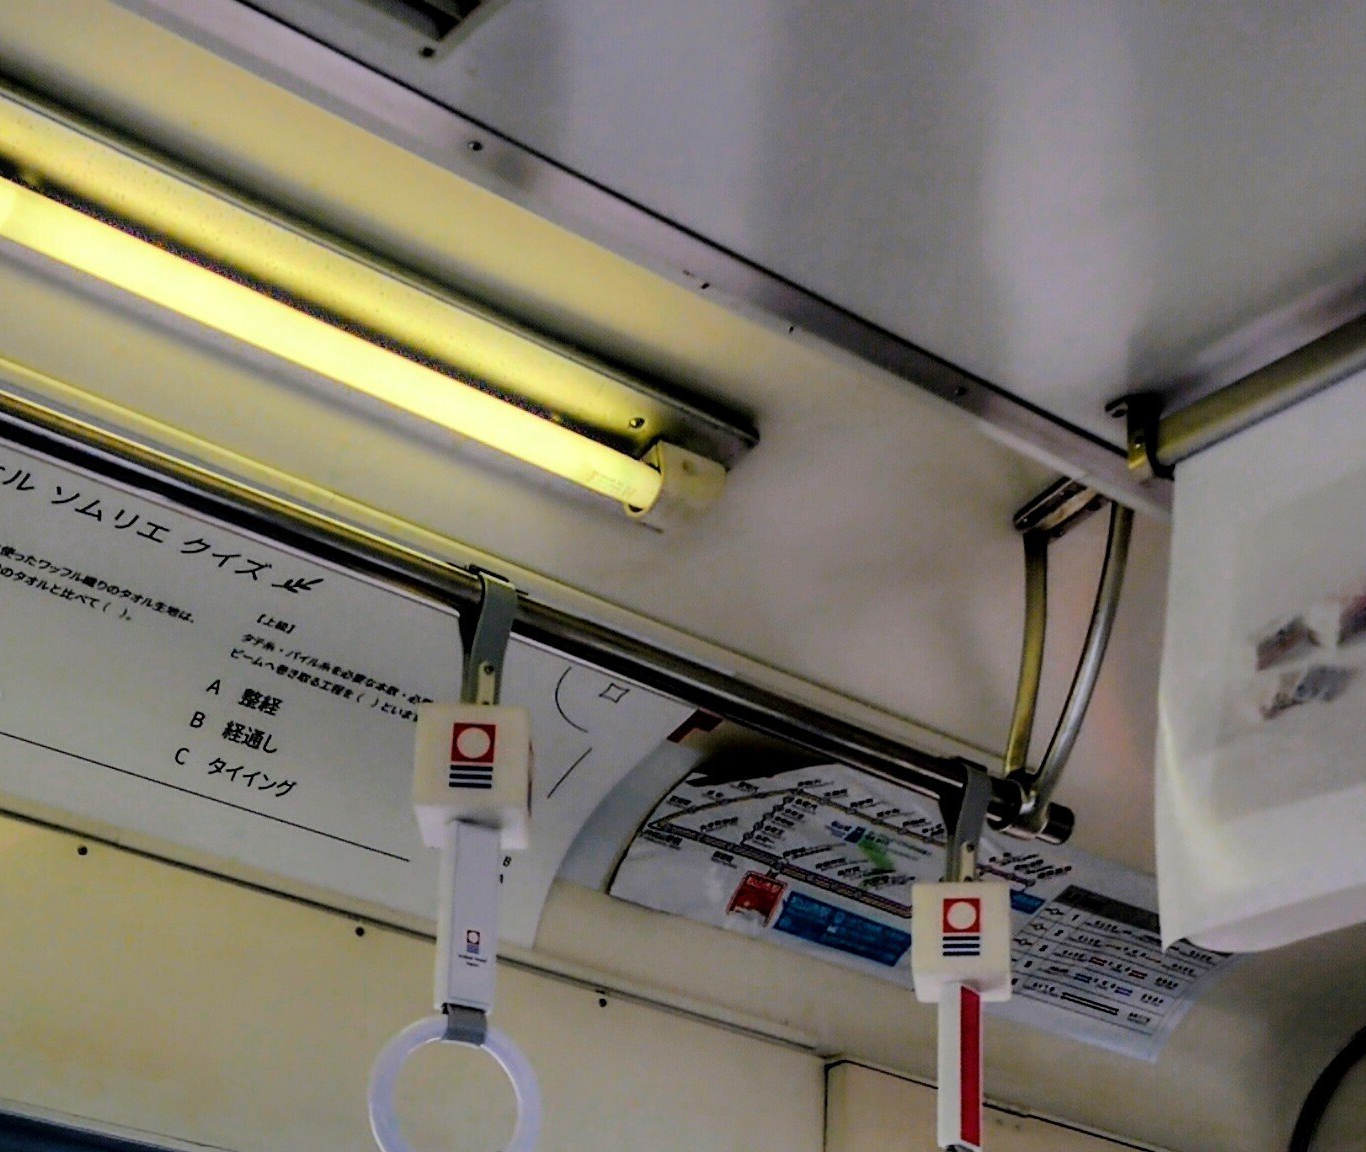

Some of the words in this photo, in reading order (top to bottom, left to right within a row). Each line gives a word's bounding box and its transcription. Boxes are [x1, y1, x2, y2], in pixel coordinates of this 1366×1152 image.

[51, 485, 171, 545] ソムリエ
[180, 537, 273, 582] クイズ
[206, 679, 222, 696] A
[238, 688, 283, 716] 整経
[190, 711, 206, 729] B
[222, 720, 279, 755] 経通し
[174, 747, 190, 766] C
[208, 757, 298, 798] タイイング
